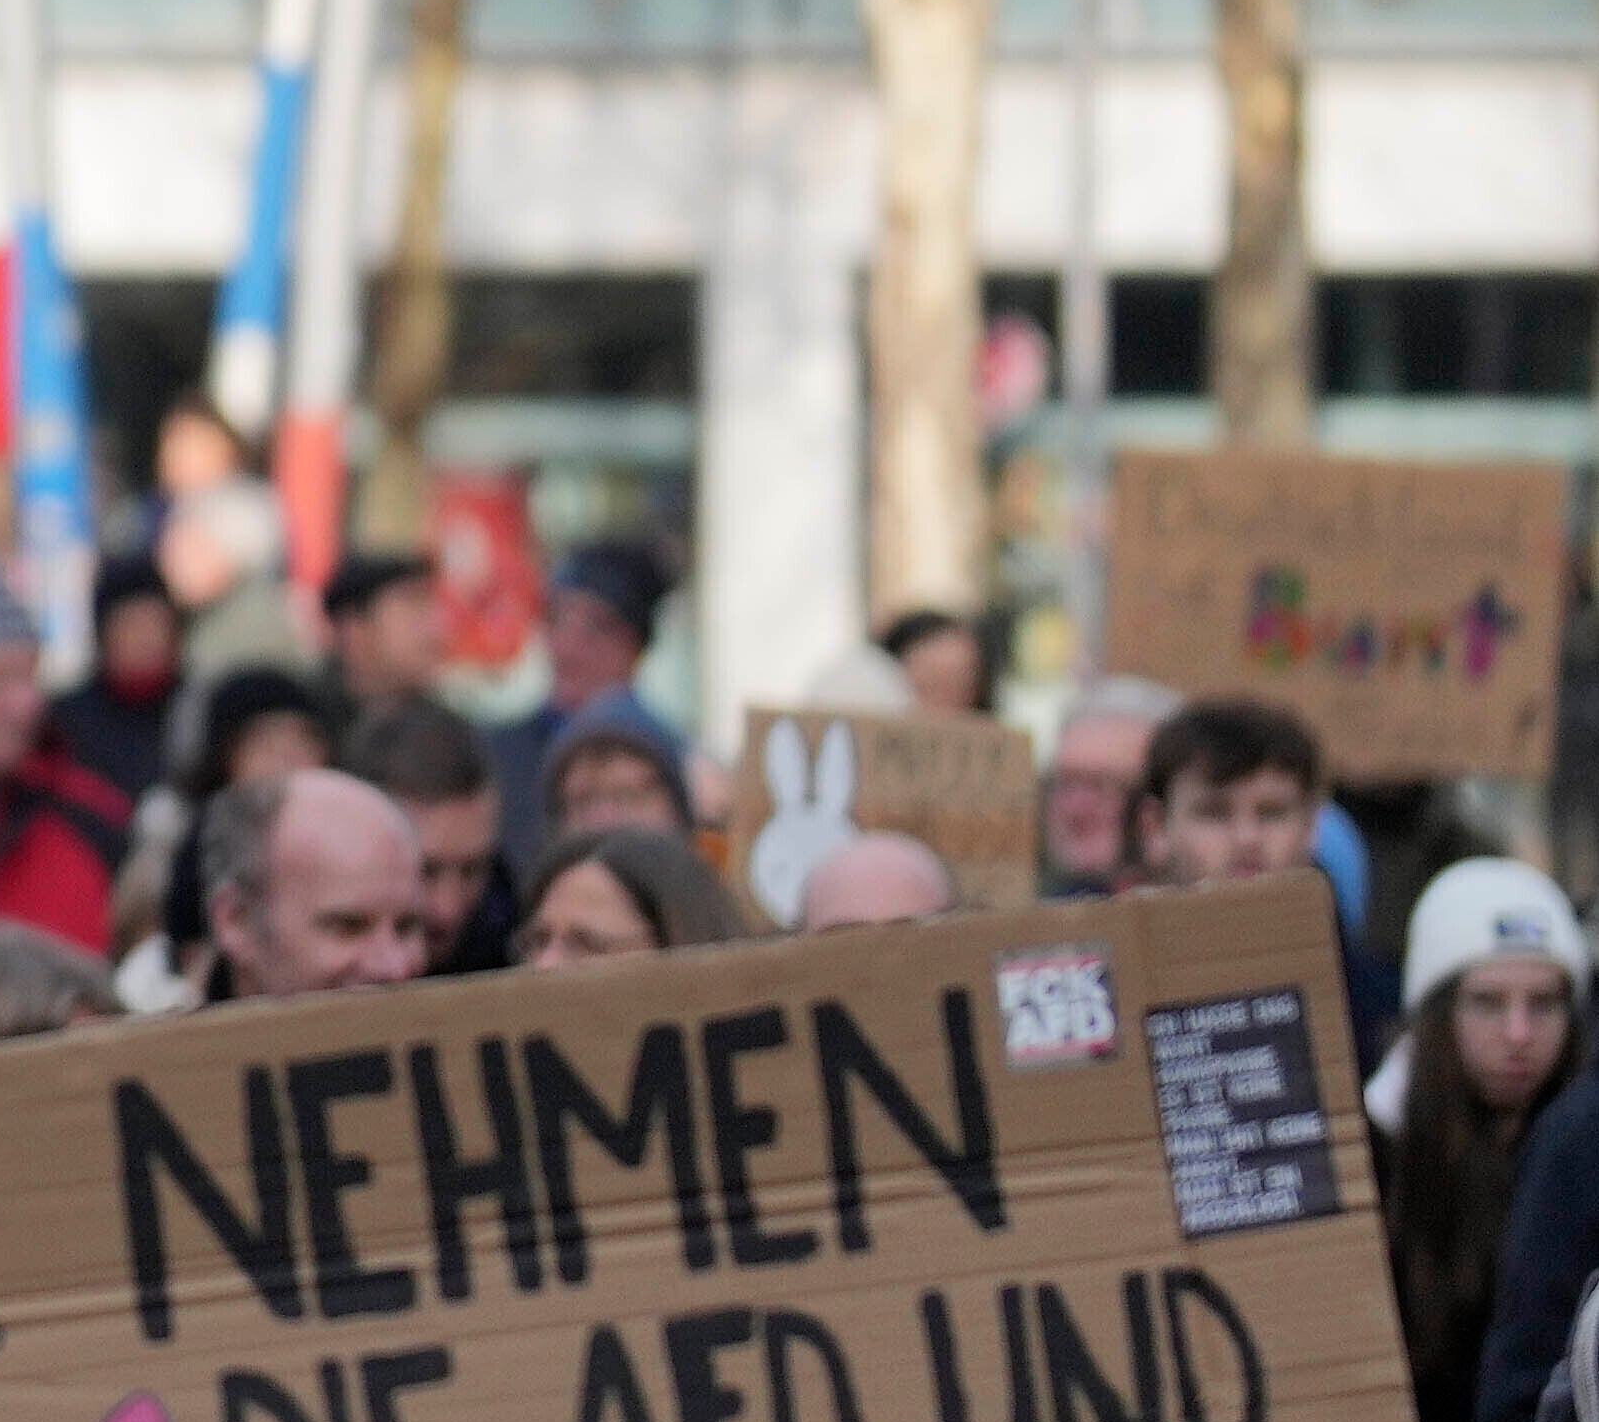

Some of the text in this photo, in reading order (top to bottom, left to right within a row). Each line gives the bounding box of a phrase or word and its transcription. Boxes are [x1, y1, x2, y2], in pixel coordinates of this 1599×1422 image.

[996, 961, 1106, 1010] FCK
[1005, 995, 1115, 1050] AFD
[113, 989, 1012, 1342] NEHMEN
